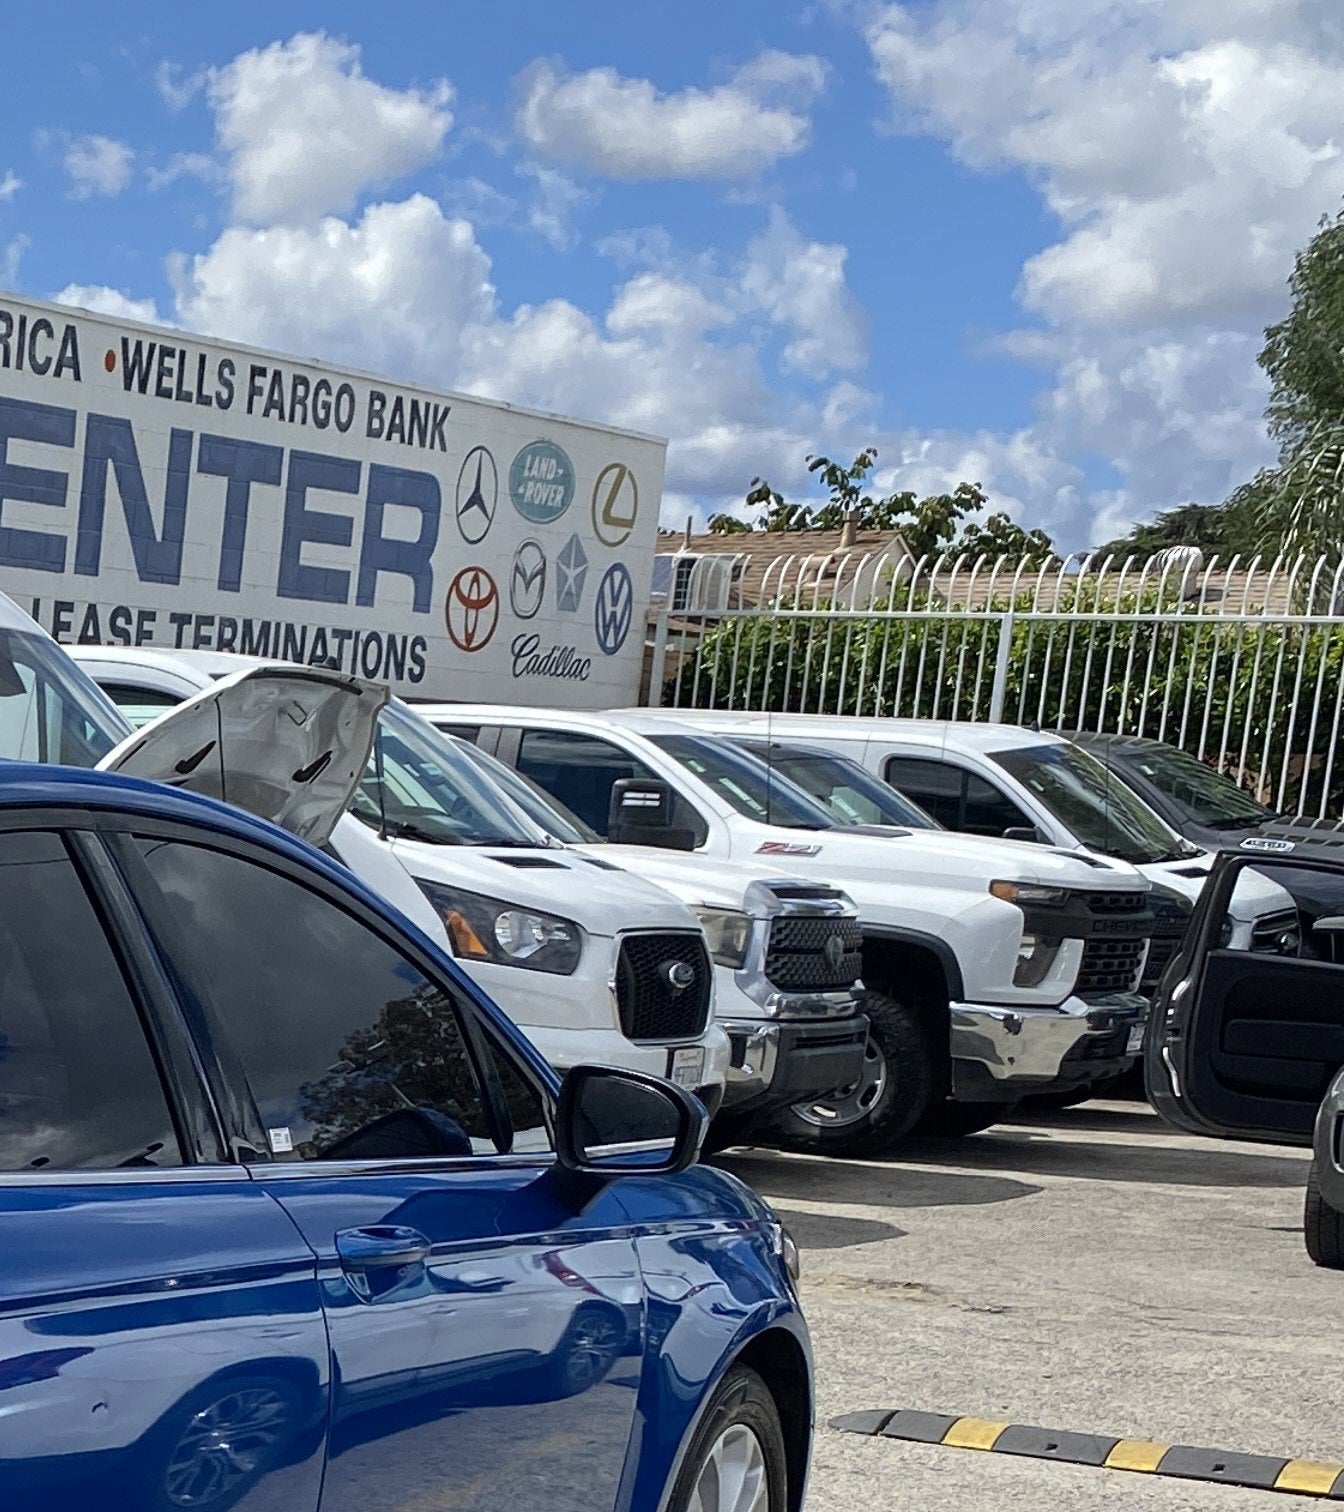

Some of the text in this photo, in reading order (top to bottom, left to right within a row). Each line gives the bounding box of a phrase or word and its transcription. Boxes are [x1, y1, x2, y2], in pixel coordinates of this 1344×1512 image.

[120, 335, 236, 412] WELLS
[246, 365, 355, 434] FARGO
[366, 389, 452, 453] BANK
[169, 611, 428, 684] TERMINATIONS
[510, 632, 591, 681] Cadillac
